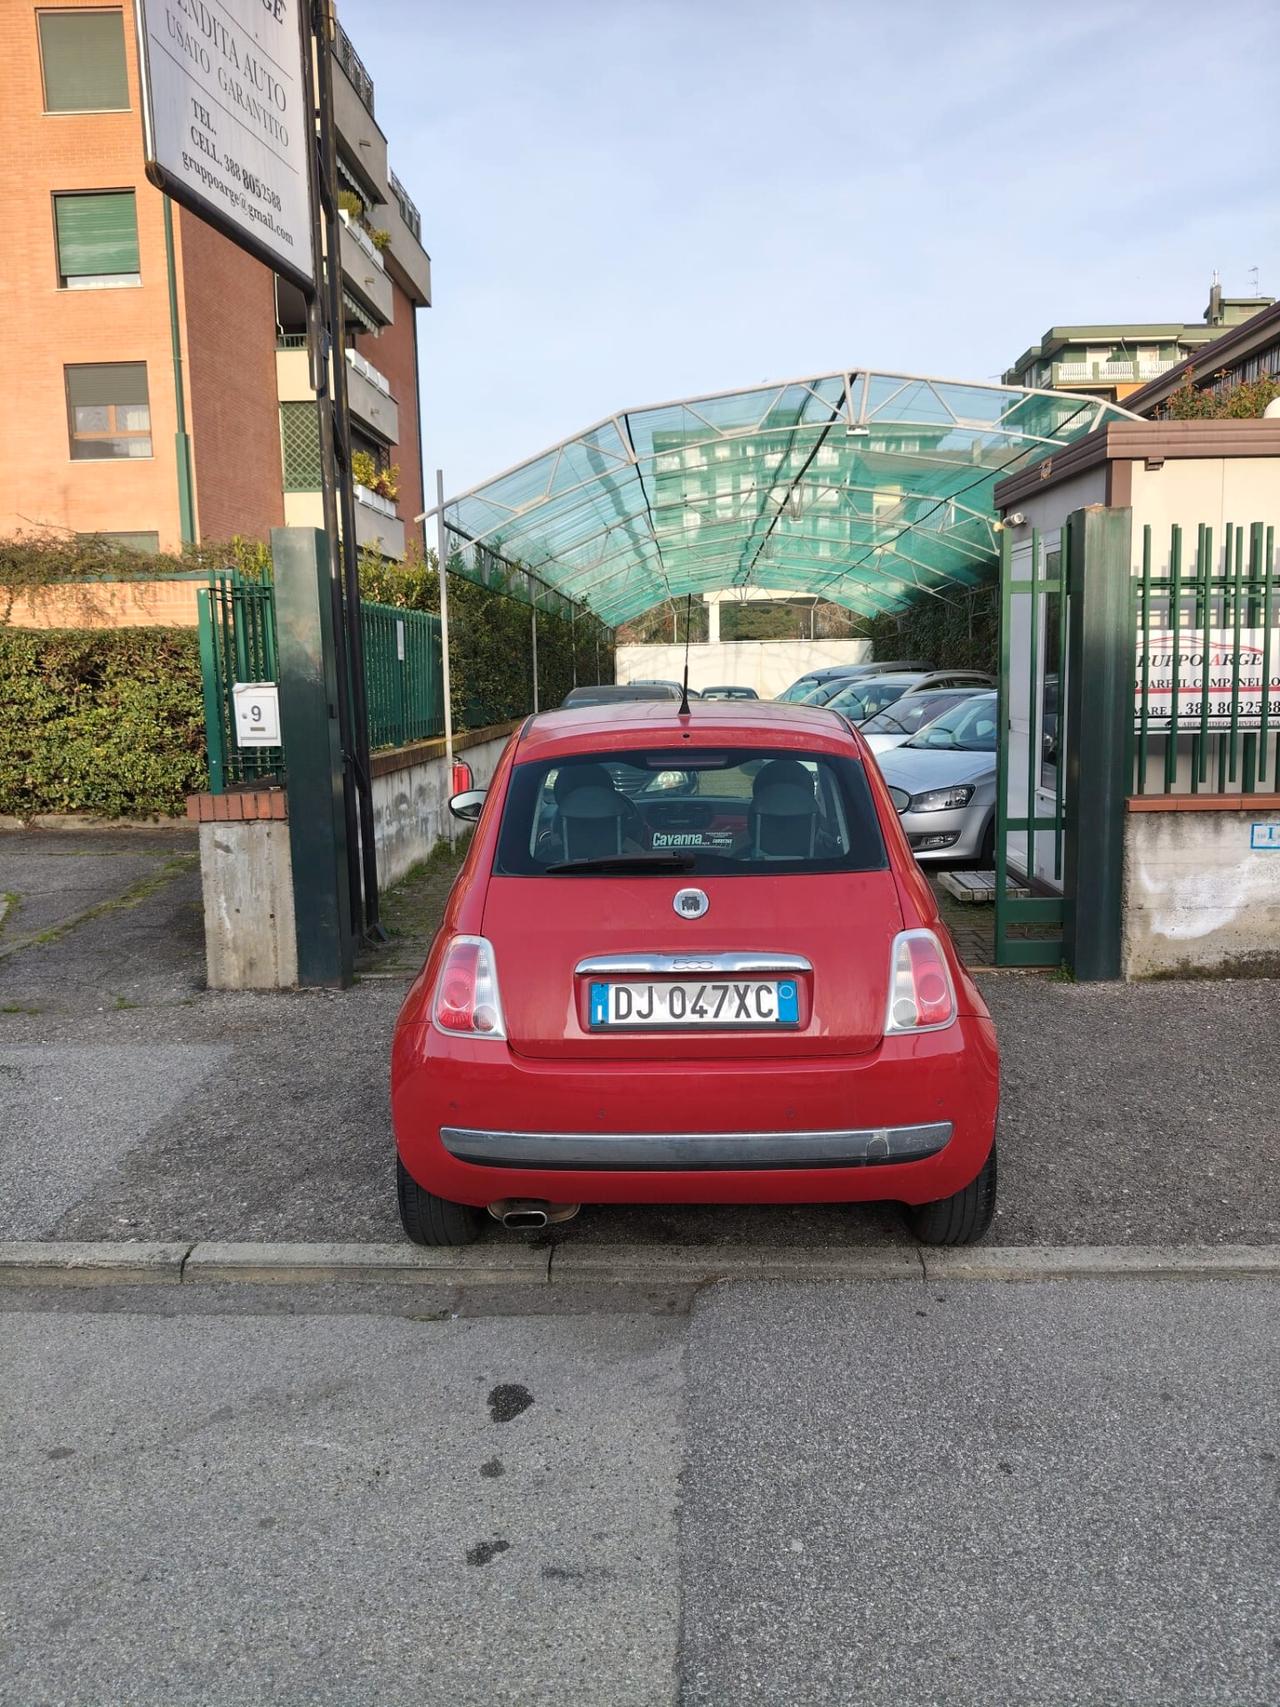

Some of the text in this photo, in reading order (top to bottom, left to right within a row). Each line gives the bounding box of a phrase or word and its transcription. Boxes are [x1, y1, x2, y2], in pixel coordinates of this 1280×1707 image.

[166, 8, 289, 147] USATO GARANTITO
[243, 52, 287, 112] AUTO
[191, 97, 217, 135] TEL.
[190, 125, 282, 212] CELL. 388 8052588
[182, 151, 294, 247] gruppoarge@gmail.com
[1193, 677, 1280, 688] CMPNELO
[251, 705, 262, 722] 9
[652, 832, 703, 846] Cavanna
[614, 985, 654, 1020] DJ
[668, 984, 774, 1020] 047XC
